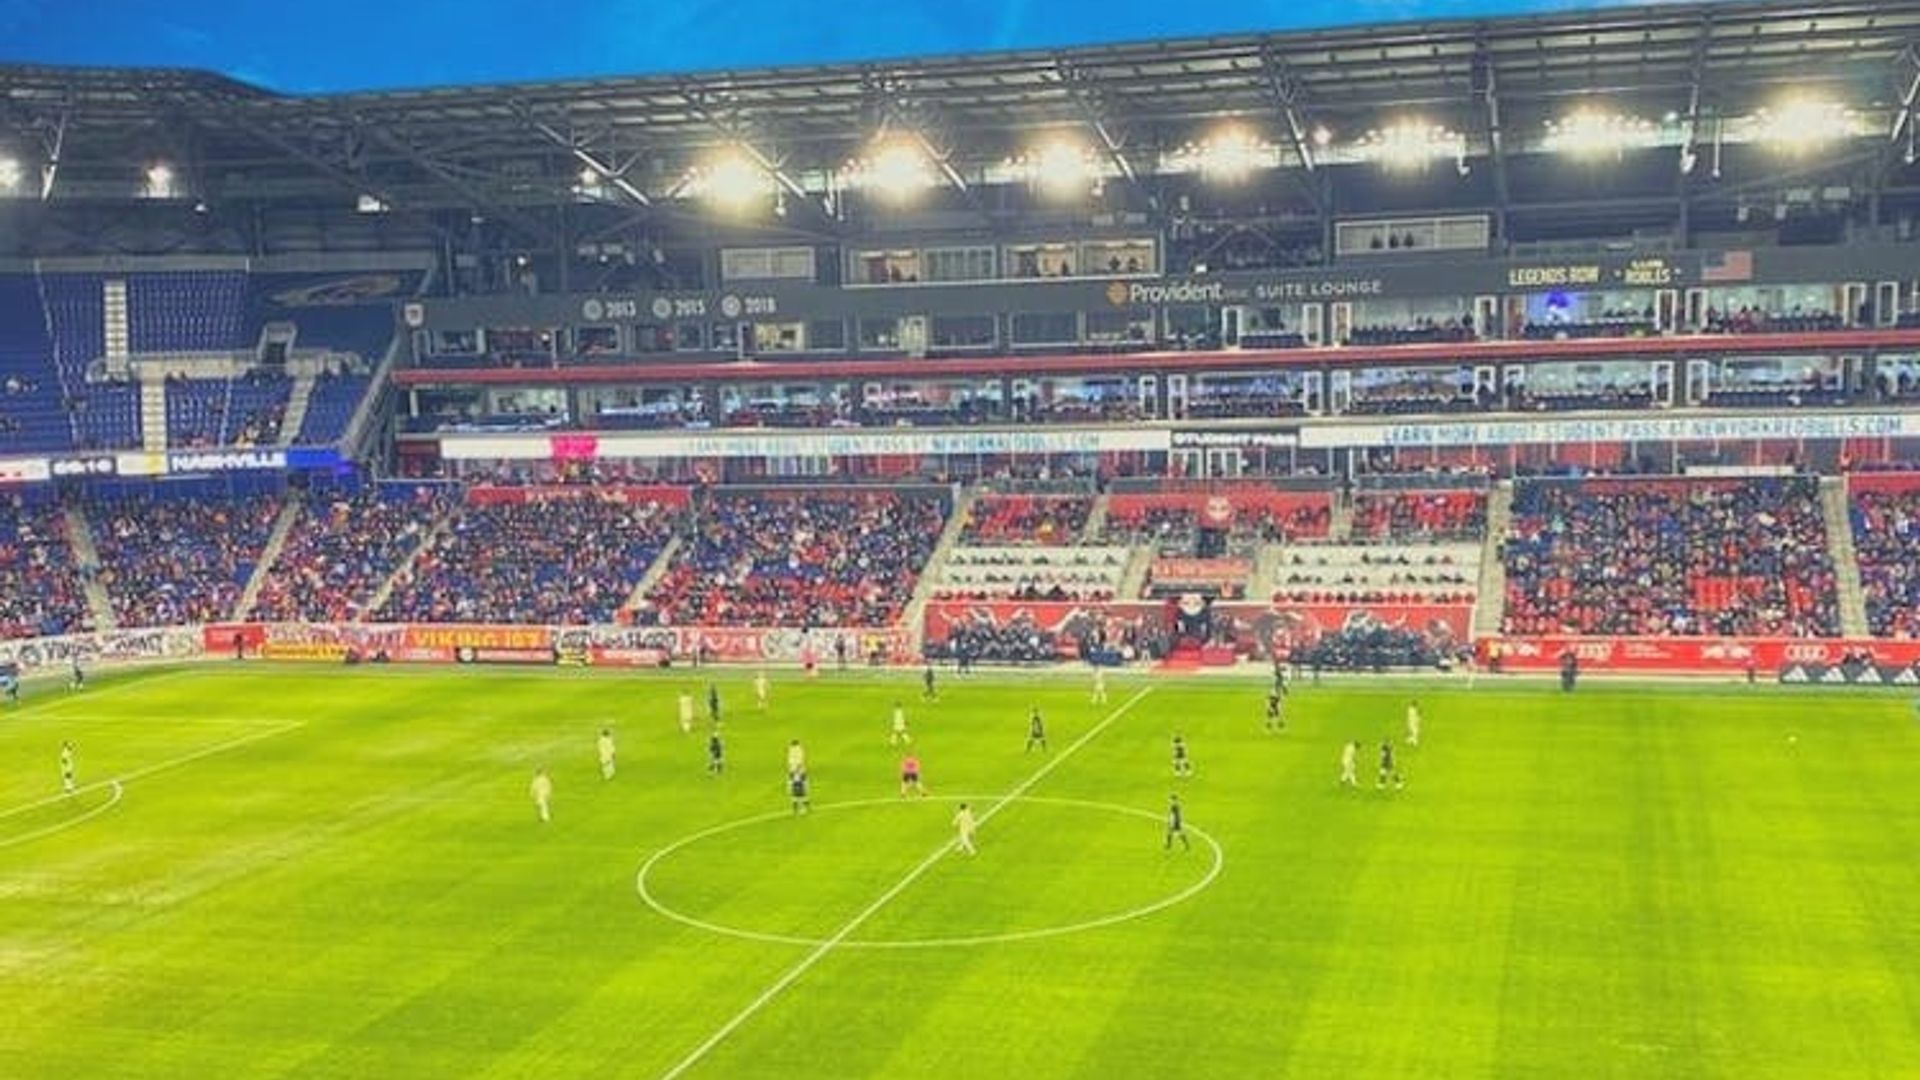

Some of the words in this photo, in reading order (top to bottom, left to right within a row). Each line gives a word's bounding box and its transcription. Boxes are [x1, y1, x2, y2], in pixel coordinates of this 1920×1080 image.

[1509, 269, 1566, 285] LEGENDS
[1569, 267, 1599, 282] ROW
[1130, 281, 1222, 301] Provident
[1256, 284, 1304, 298] SUITE
[1311, 281, 1382, 296] LOUNGE
[1174, 433, 1246, 446] STUDENT
[1384, 425, 1434, 442] LEARN
[172, 453, 286, 470] NASHVILLE
[412, 629, 497, 648] VIKING
